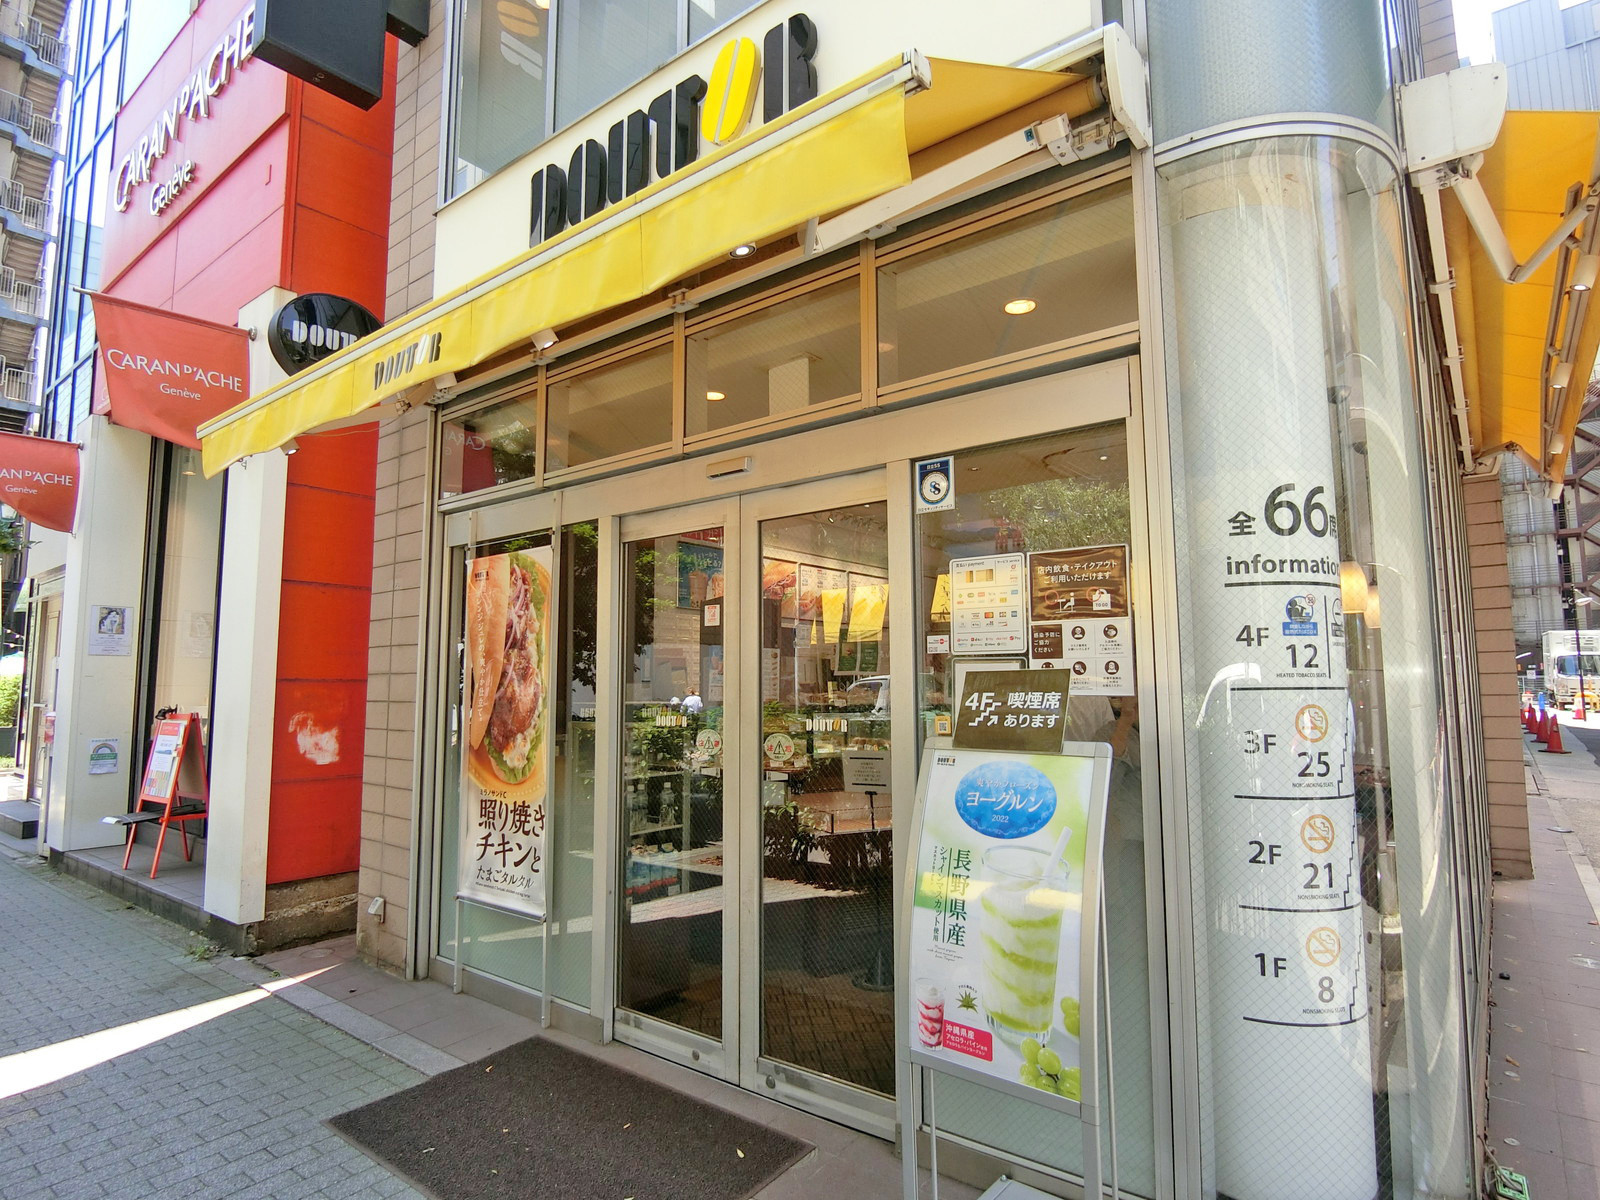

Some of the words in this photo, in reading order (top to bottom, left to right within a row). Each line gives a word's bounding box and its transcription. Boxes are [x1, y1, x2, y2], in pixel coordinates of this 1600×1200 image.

[113, 97, 181, 213] CARAN
[178, 3, 256, 121] D'ACHE
[529, 12, 818, 248] DOUTOR
[149, 159, 196, 216] Genève
[106, 348, 181, 376] CARAN
[183, 365, 243, 393] D'ACHE
[374, 331, 442, 391] DOUTOR
[159, 383, 201, 401] Genève
[5, 484, 38, 495] Genève
[25, 470, 74, 487] D'ACHE
[1037, 560, 1118, 575] 店内飲食・テイクアウト
[1043, 571, 1112, 584] ご利用いただけます
[1235, 624, 1269, 647] 4F
[1286, 643, 1319, 669] 12
[965, 692, 995, 711] 4F
[1007, 691, 1062, 709] 喫煙席
[656, 715, 688, 728] DOUTOR
[805, 718, 848, 733] DOUTOR
[1003, 713, 1060, 729] あります
[1243, 730, 1277, 754] 3F
[1297, 751, 1331, 777] 25
[976, 778, 1039, 790] 爽やかフローズン
[966, 789, 1044, 813] ヨーグルン
[478, 798, 546, 838] 照り焼き
[991, 814, 1009, 823] 2022
[476, 831, 541, 873] チキンと
[1248, 840, 1282, 865] 2F
[476, 864, 535, 889] たまごタルタル
[1302, 862, 1334, 889] 21
[932, 846, 948, 942] シャインマスカット使用
[946, 848, 972, 947] 長野県産
[1254, 952, 1287, 978] 1F
[1317, 975, 1335, 1004] 8
[945, 1023, 975, 1040] 沖縄県産
